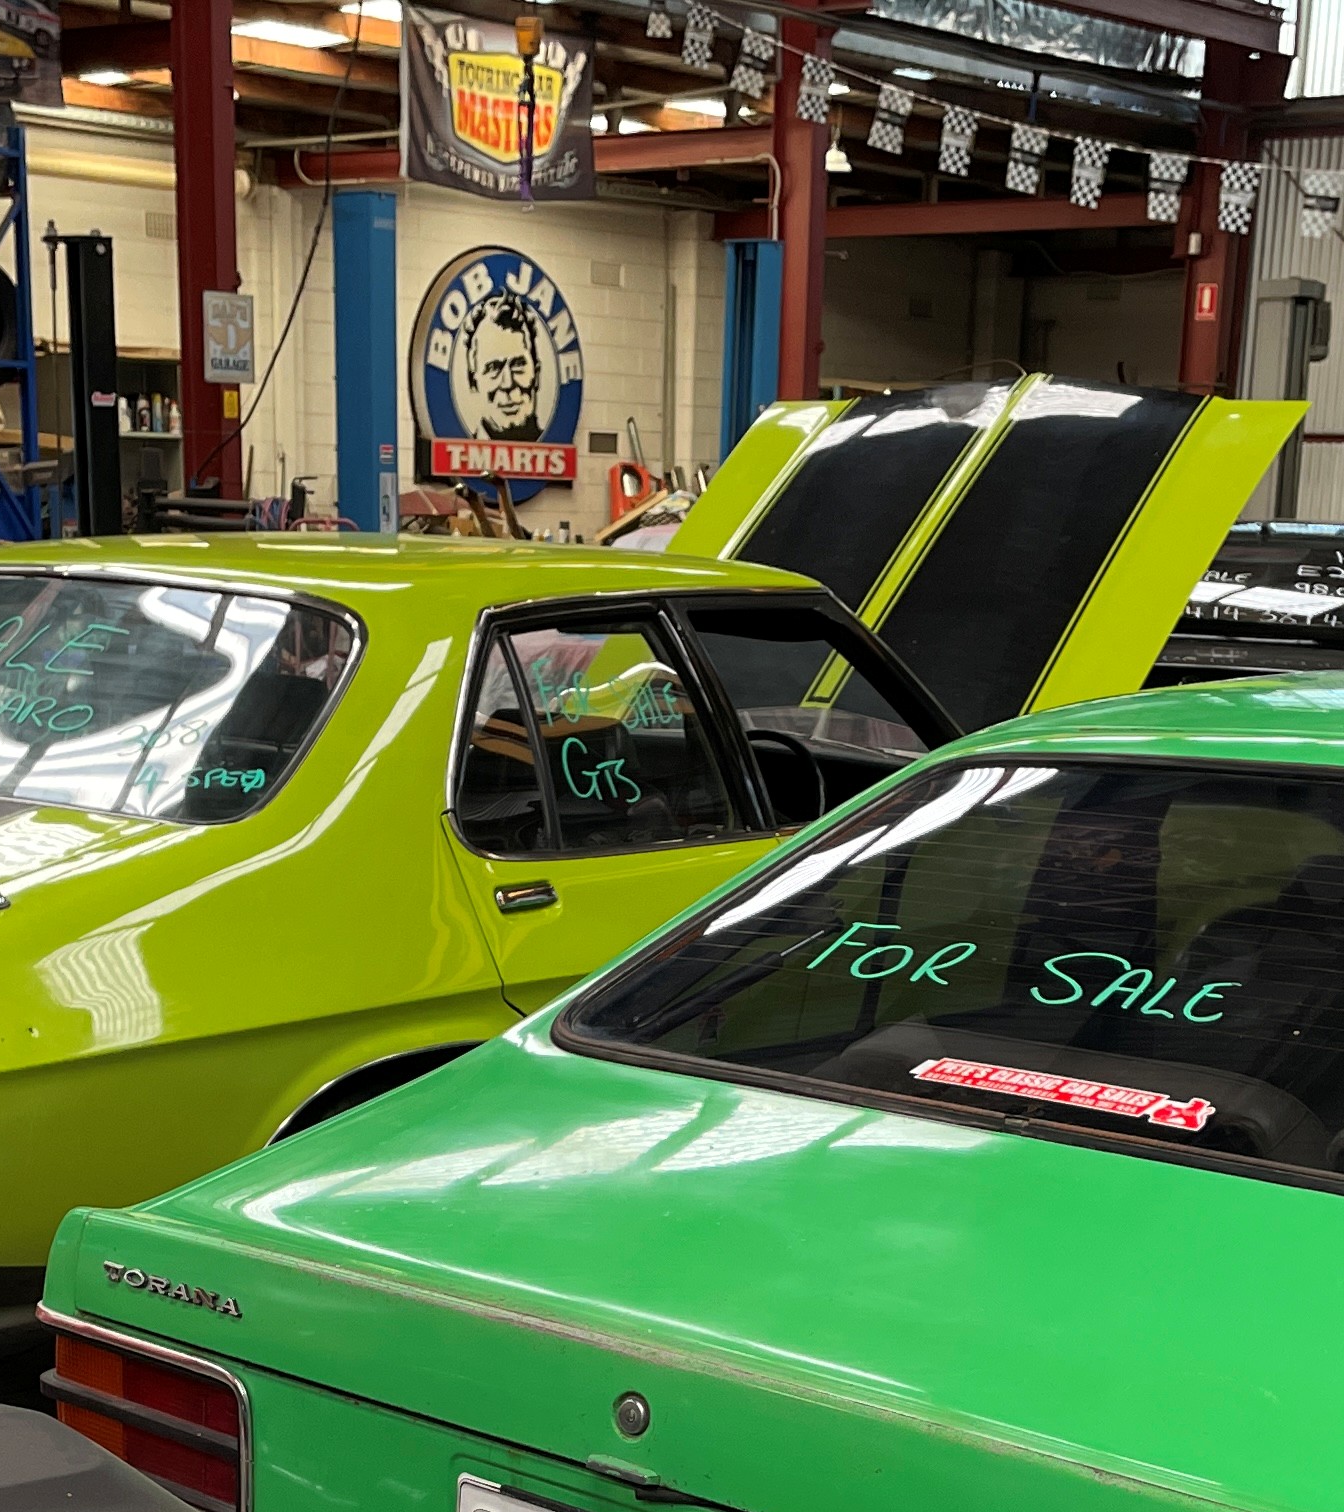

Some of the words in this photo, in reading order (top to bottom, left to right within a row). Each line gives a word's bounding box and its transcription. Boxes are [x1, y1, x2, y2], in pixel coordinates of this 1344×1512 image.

[427, 262, 494, 372] BOB
[507, 259, 582, 385] JANE
[445, 443, 567, 476] T-MARTS
[1204, 569, 1253, 583] ALE
[532, 657, 590, 727] FOR
[134, 765, 169, 794] 4
[807, 921, 976, 985] FOR
[1031, 952, 1242, 1023] SALE
[935, 1060, 994, 1079] PETE'S
[989, 1070, 1064, 1091] CLASSIC
[1059, 1081, 1102, 1097] CAR
[1096, 1088, 1153, 1107] SALES
[101, 1259, 244, 1319] TORANA
